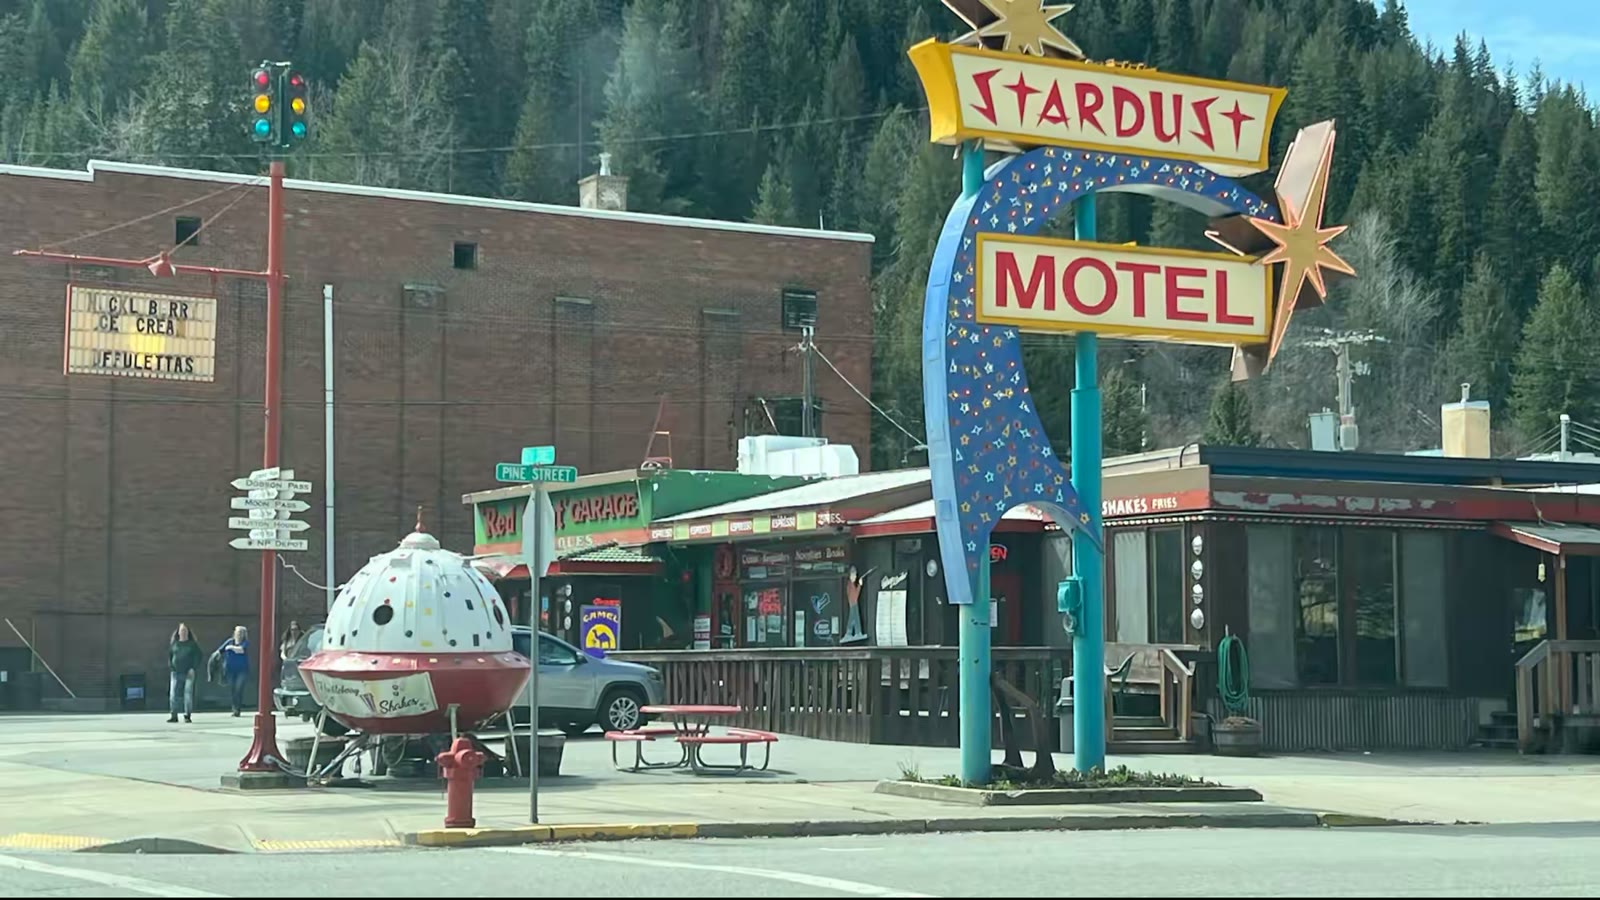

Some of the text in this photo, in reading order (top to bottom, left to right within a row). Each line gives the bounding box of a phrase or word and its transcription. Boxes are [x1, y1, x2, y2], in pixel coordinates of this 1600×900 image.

[970, 68, 1255, 152] STARDUST
[995, 251, 1254, 326] MOTEL
[135, 318, 186, 338] CREA
[502, 467, 571, 482] PINE STREET
[571, 494, 639, 524] GARAGE
[1102, 497, 1178, 515] SHAKES FRIES
[582, 610, 619, 624] CAMEL
[379, 697, 419, 714] Shakes
